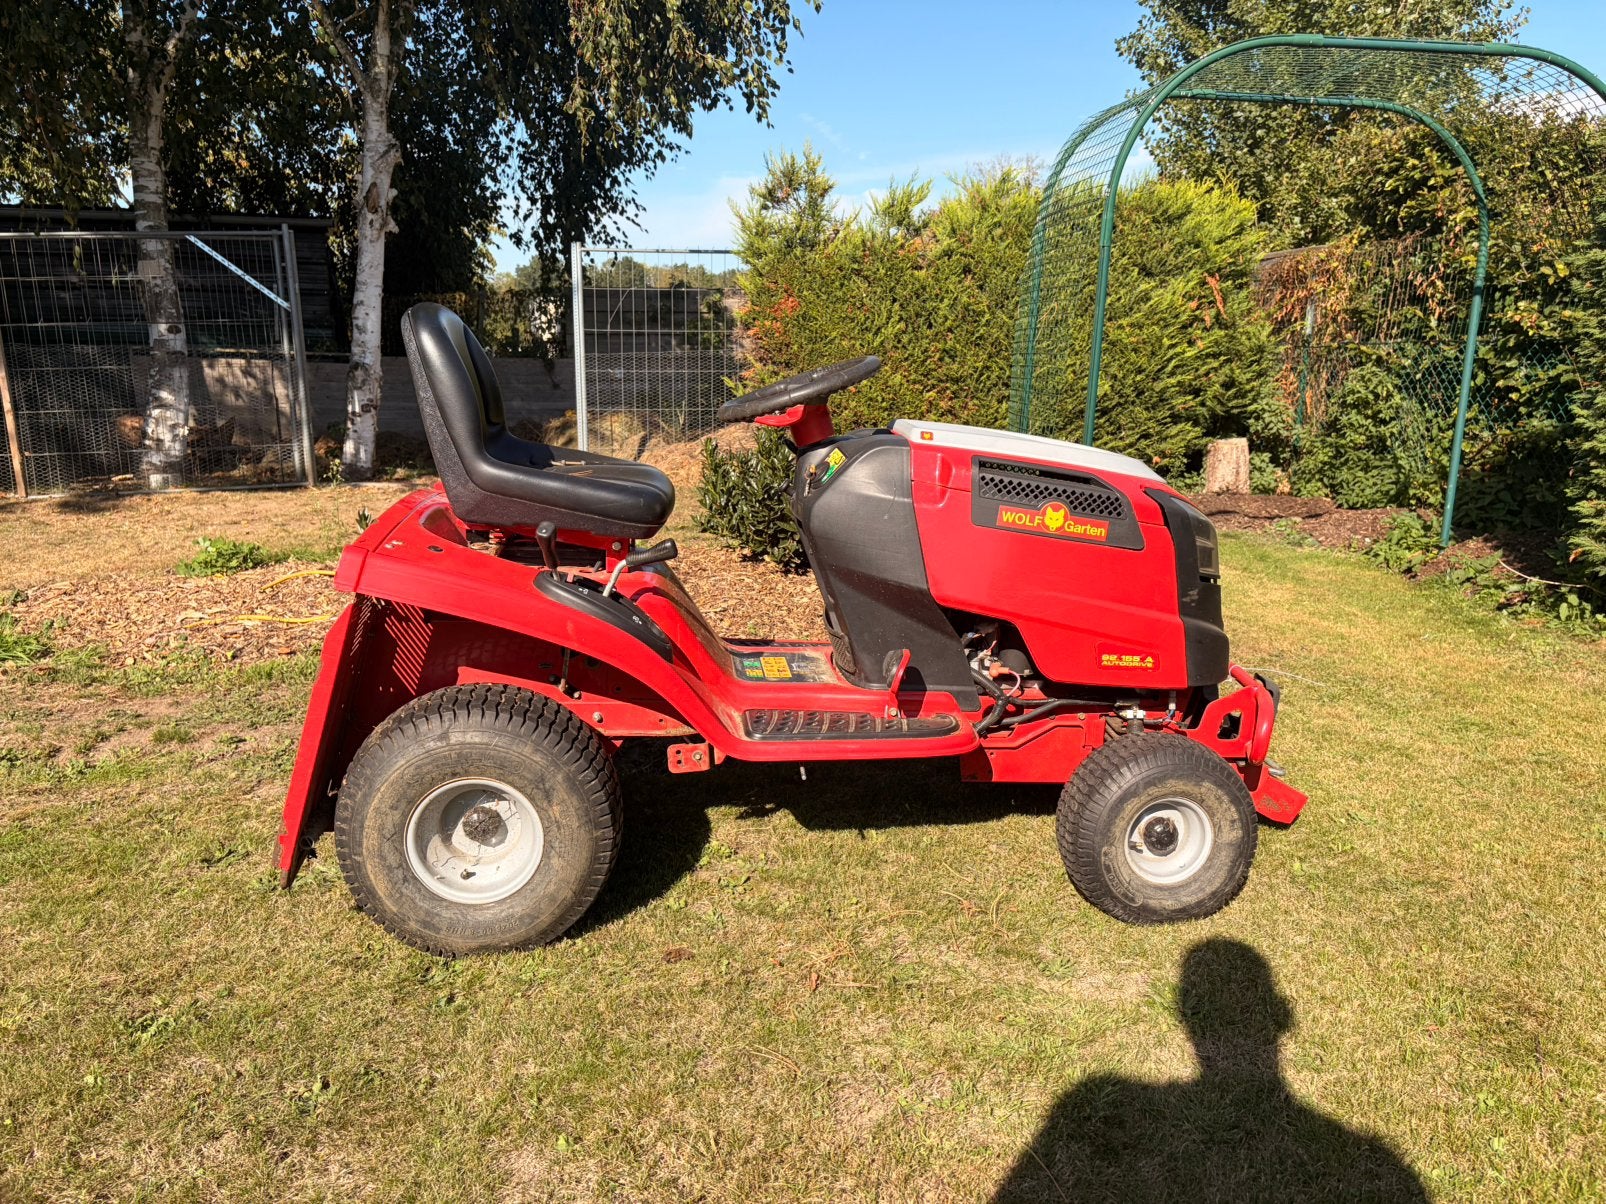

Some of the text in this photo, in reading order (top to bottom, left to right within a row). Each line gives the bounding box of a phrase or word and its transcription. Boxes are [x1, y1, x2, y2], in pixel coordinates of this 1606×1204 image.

[1001, 511, 1106, 537] WOLF Garten
[1101, 660, 1153, 668] AUTODRIVE
